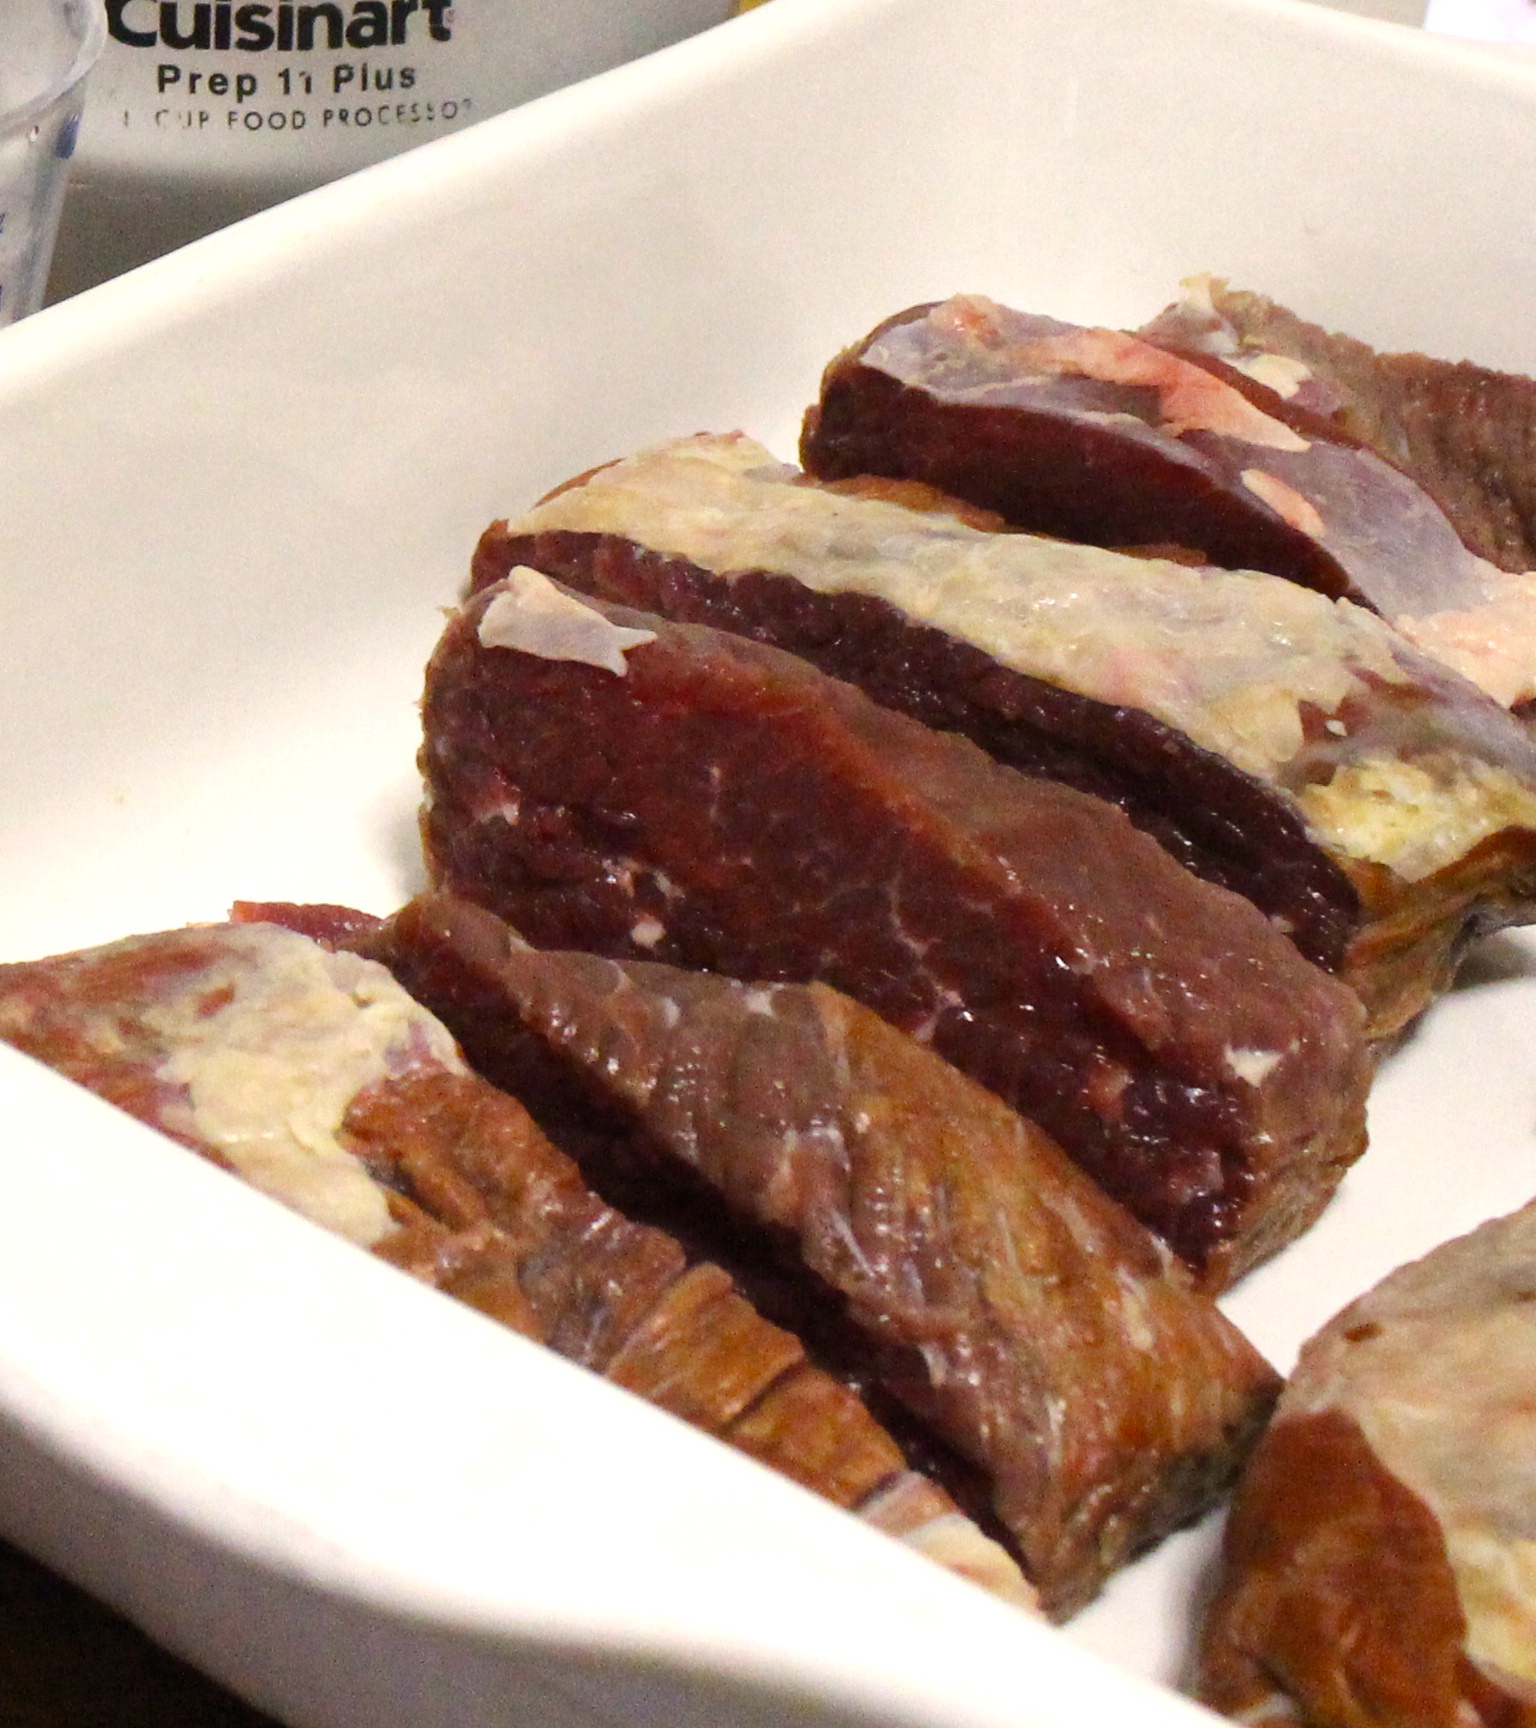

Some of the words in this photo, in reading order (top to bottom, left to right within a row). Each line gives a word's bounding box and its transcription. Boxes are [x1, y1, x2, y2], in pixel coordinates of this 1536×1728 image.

[157, 63, 257, 103] Prep
[278, 68, 313, 95] 11
[333, 63, 416, 94] Plus
[227, 109, 306, 131] FOOD
